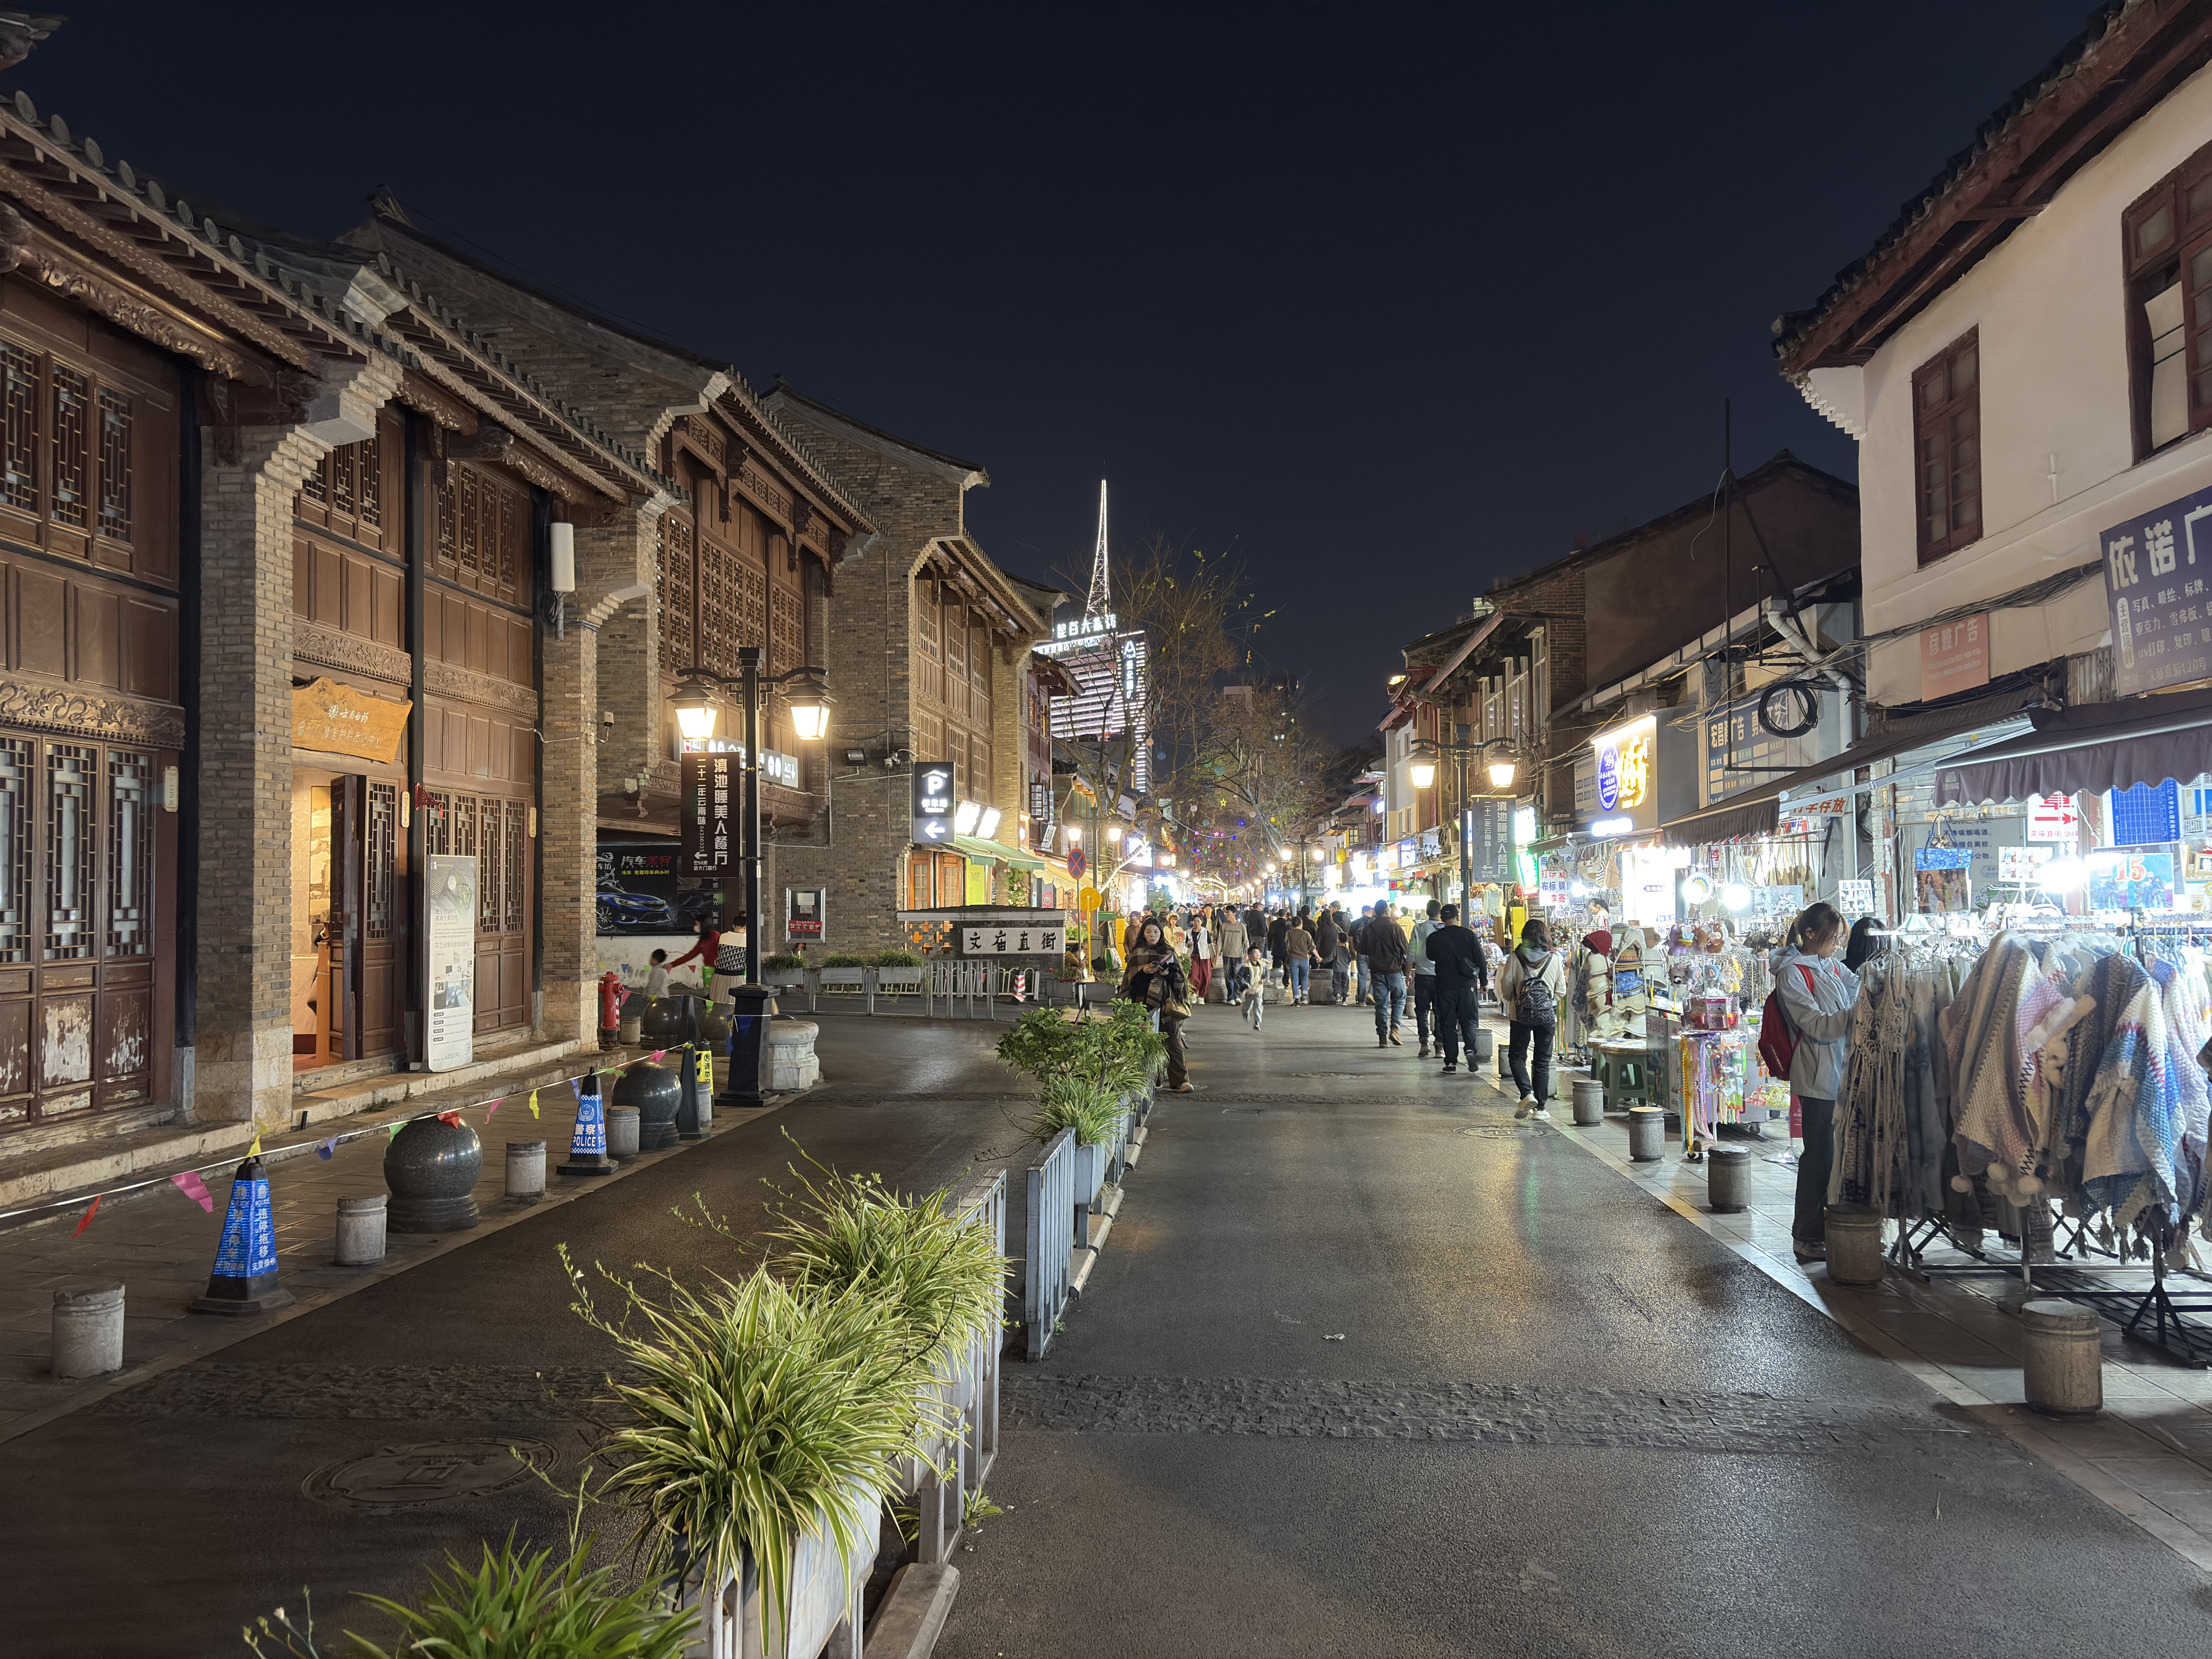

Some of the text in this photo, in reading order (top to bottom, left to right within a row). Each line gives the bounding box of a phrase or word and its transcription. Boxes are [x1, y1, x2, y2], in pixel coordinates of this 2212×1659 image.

[2109, 504, 2212, 591] 依诺广
[340, 708, 369, 723] 云南白药
[697, 759, 706, 826] 二十二年云南味
[928, 776, 943, 795] P
[714, 758, 728, 865] 滇池睡美人餐厅
[1497, 801, 1507, 874] 滇池睡美人餐厅
[620, 855, 672, 865] 汽车美容
[1542, 881, 1556, 891] 布标
[969, 930, 1057, 952] 文庙直街
[575, 1123, 595, 1135] 警察
[573, 1136, 596, 1147] POLICE
[255, 1198, 270, 1206] POLICE
[258, 1208, 269, 1258] 违停拖移
